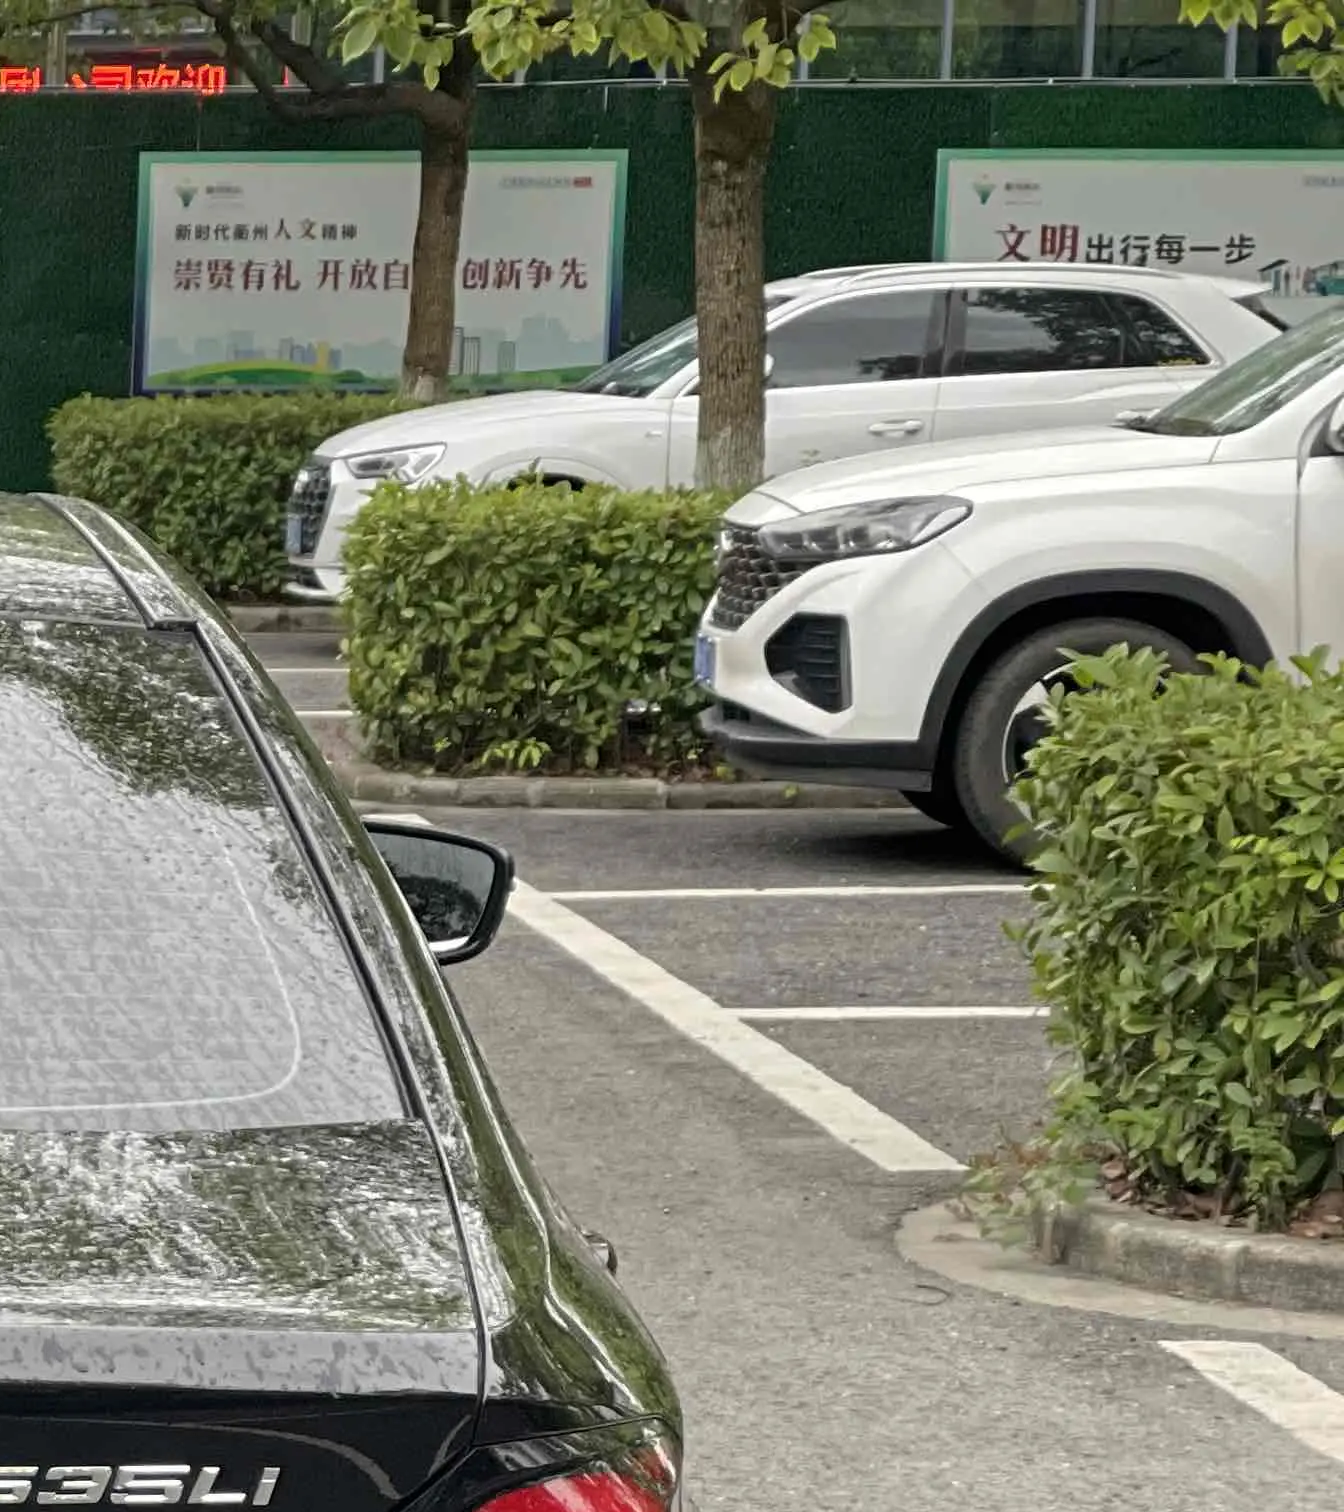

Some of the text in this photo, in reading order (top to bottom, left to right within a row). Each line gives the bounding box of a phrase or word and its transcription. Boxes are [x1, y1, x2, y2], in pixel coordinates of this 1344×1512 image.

[996, 223, 1256, 265] 文明出行每一步
[174, 256, 589, 292] 崇贤有礼 开放自 创新争先
